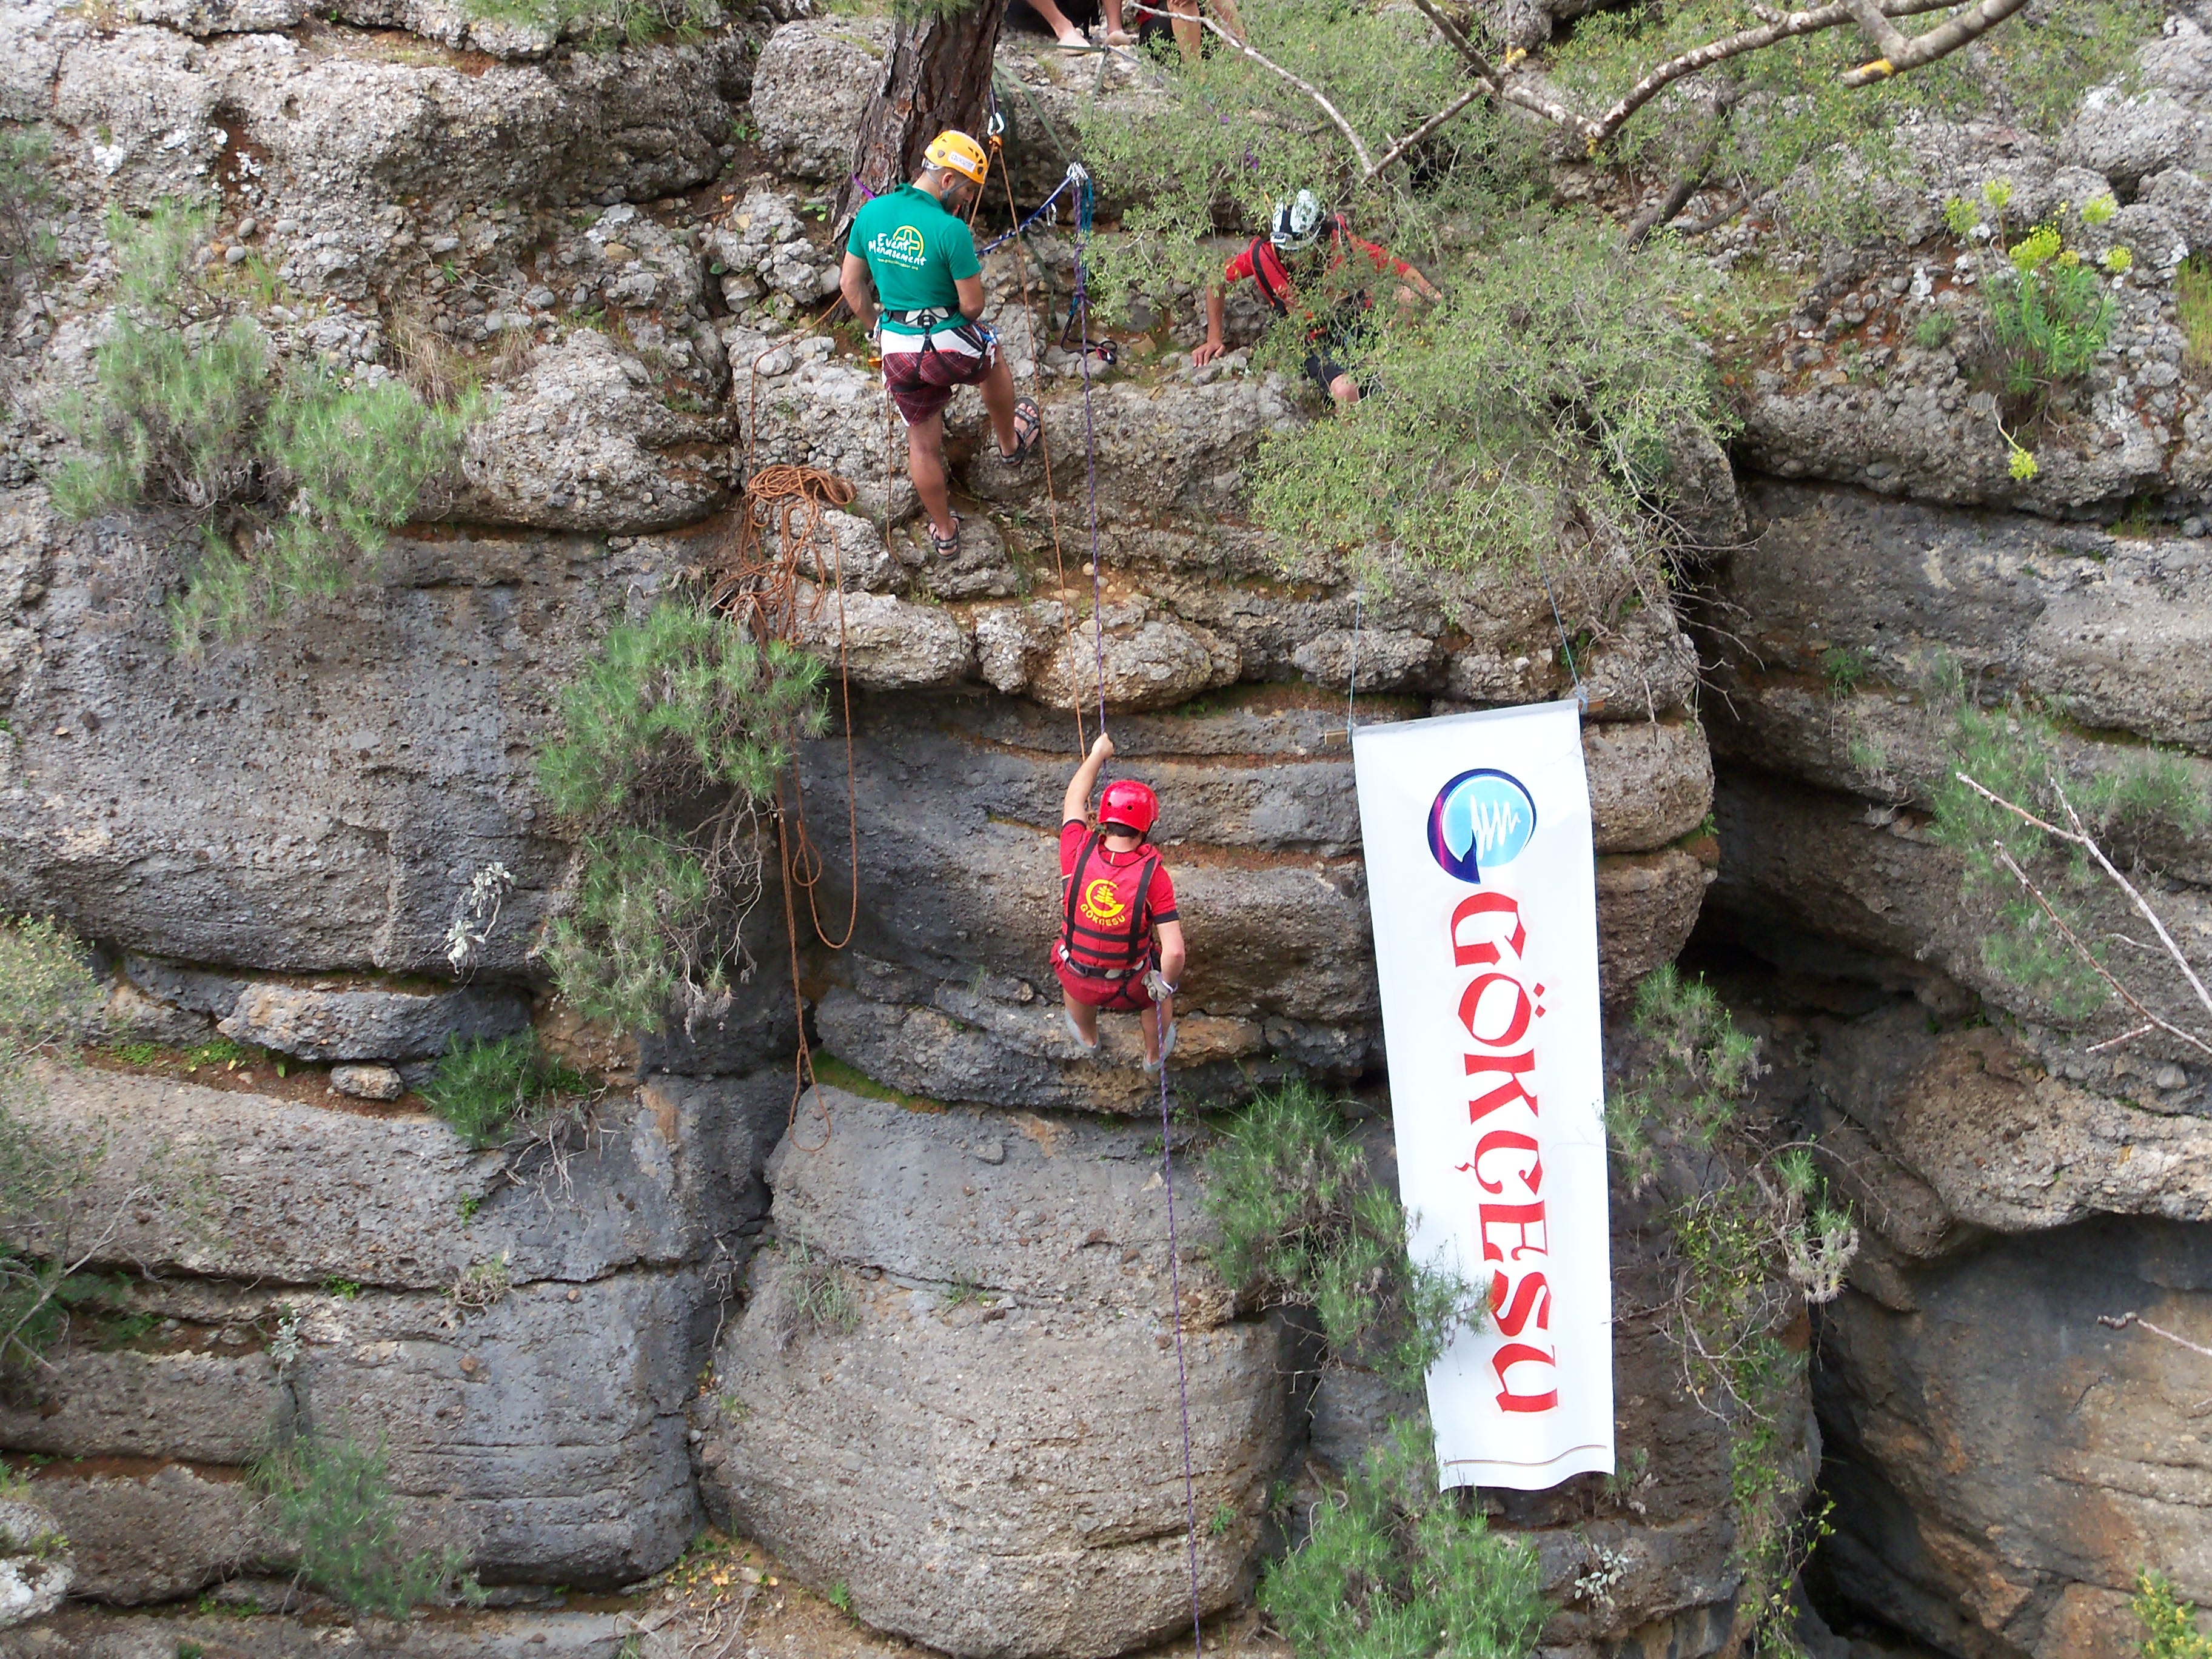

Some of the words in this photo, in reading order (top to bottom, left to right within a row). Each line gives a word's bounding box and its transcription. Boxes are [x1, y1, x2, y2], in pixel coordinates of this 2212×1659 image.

[868, 240, 927, 266] Management
[877, 233, 910, 251] Event
[1450, 891, 1559, 1413] GÖKÇESU
